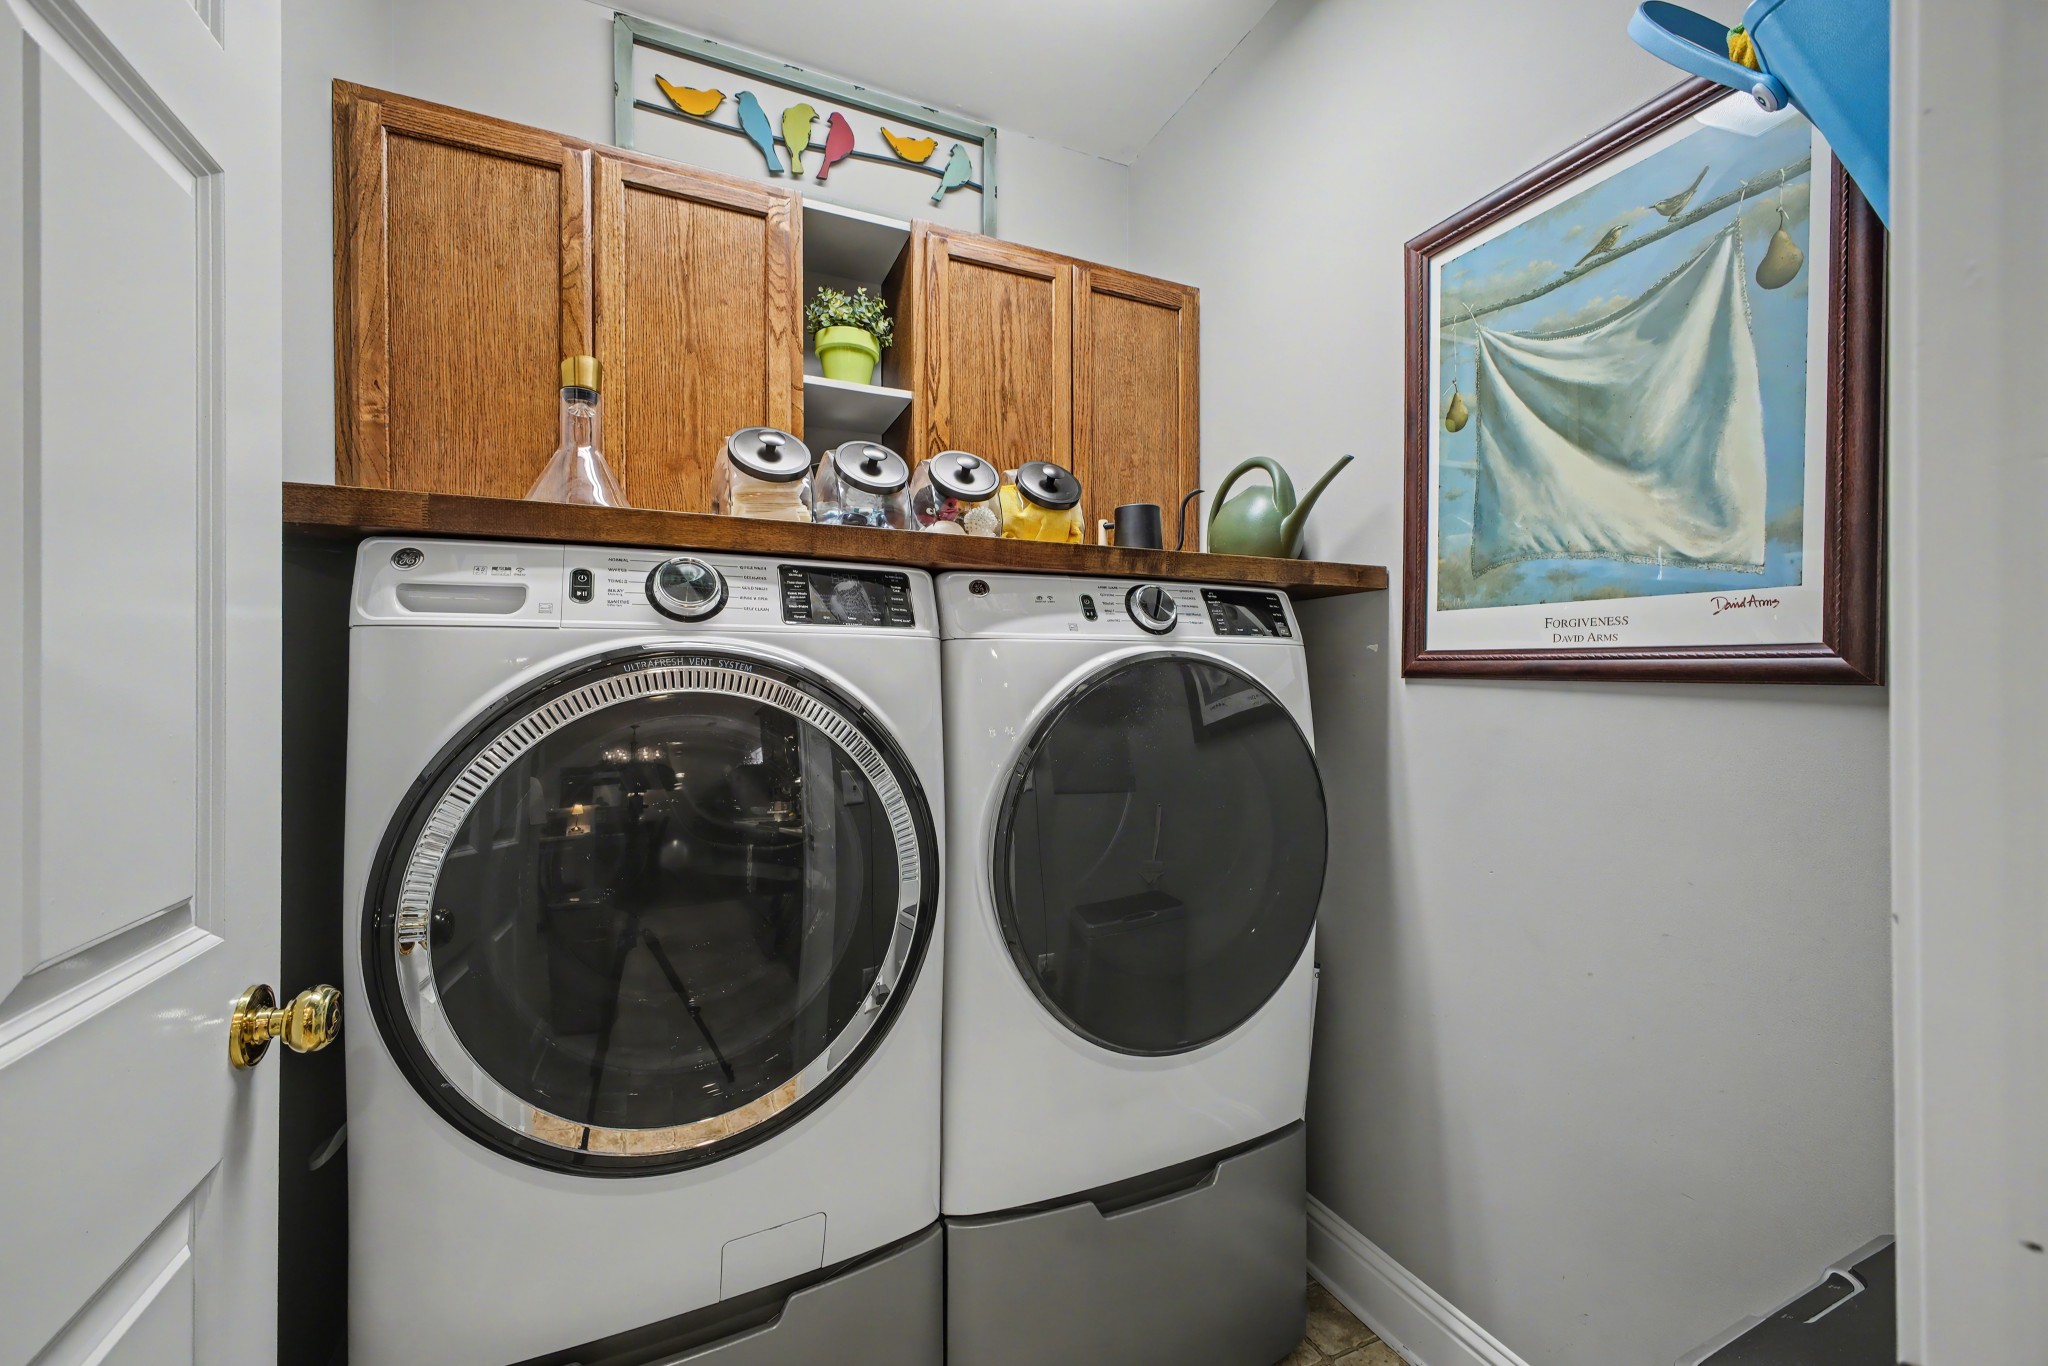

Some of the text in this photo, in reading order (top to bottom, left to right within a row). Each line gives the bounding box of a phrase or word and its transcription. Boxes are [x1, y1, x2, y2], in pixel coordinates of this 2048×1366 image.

[1710, 596, 1746, 615] David
[1544, 615, 1629, 629] FORGIVENESS
[1552, 632, 1619, 643] DAVID ARMS
[623, 657, 754, 673] ULTRAFRESH VENT SYSTEM
